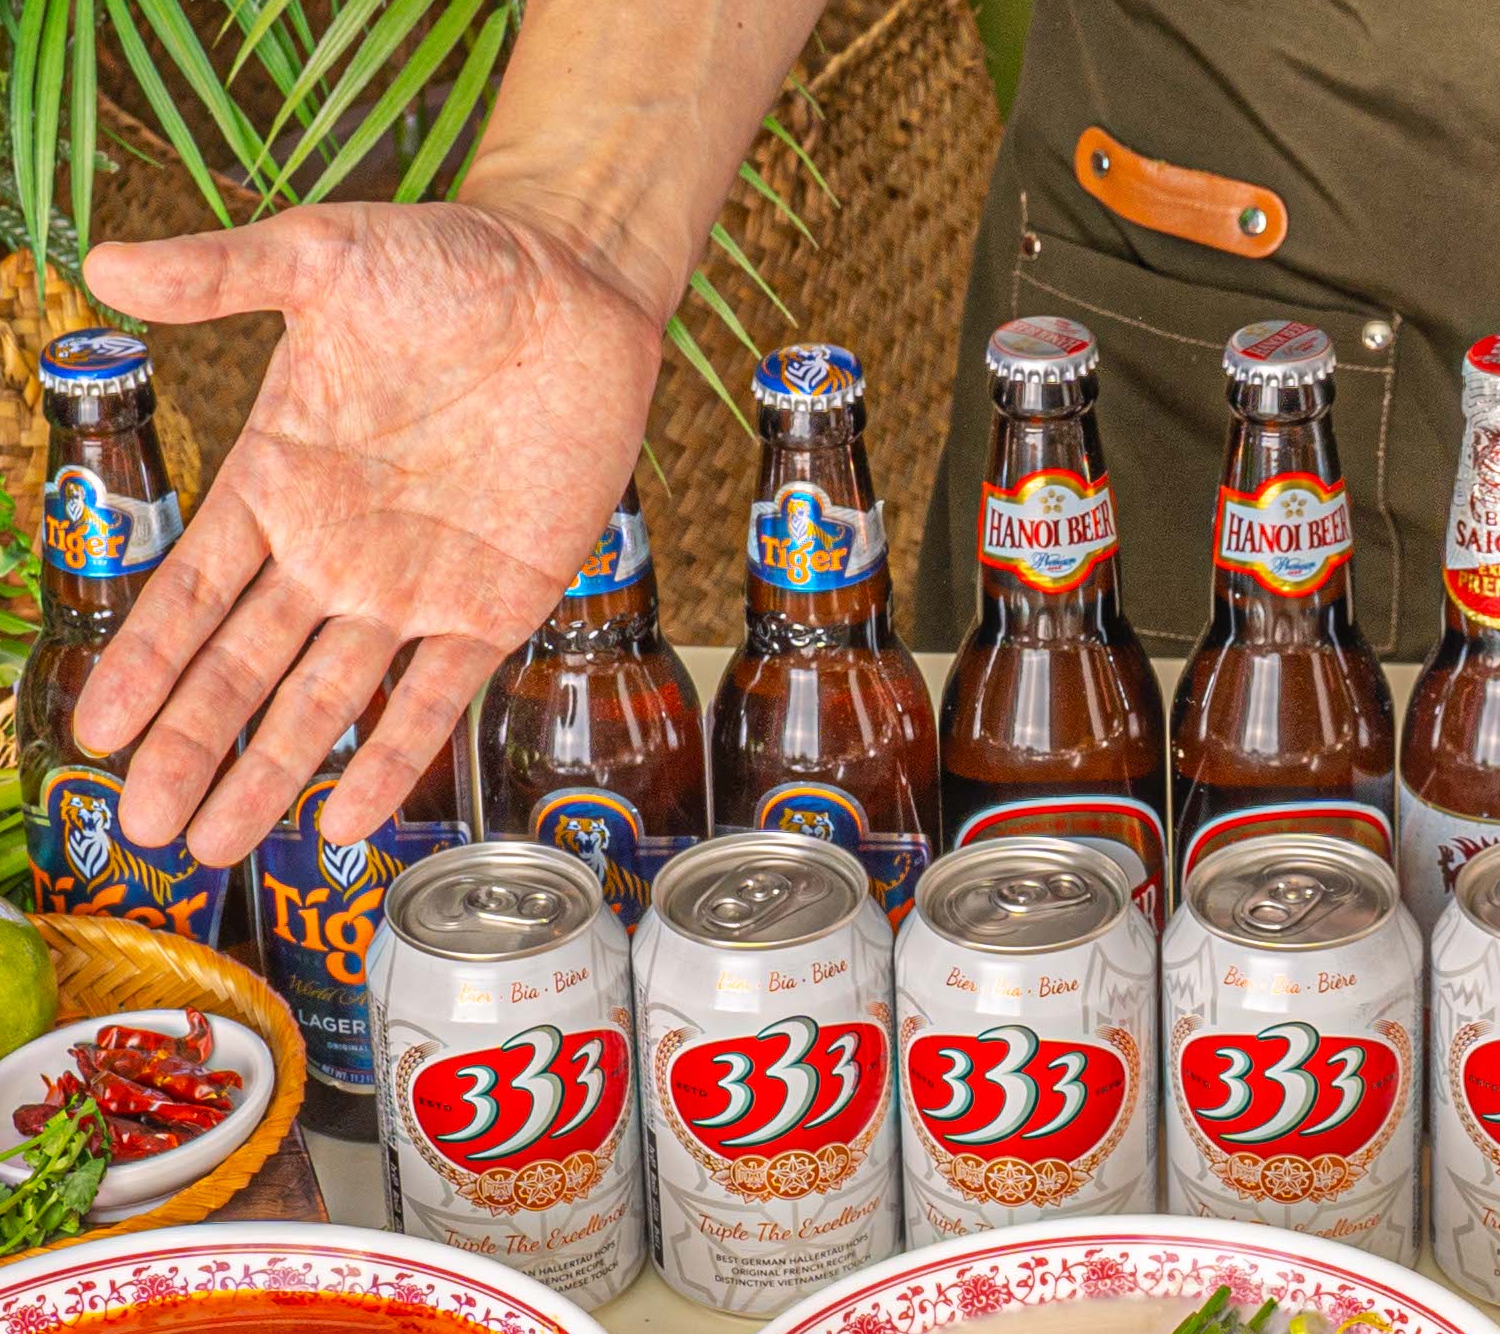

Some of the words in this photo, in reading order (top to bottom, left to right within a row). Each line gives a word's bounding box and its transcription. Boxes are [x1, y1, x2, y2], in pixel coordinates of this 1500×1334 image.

[46, 515, 125, 570] Tiger
[988, 507, 1062, 549] HANOI
[1066, 499, 1114, 546] BEER
[1226, 511, 1302, 553] HANOI
[1307, 503, 1350, 550] BEER
[760, 534, 848, 584] Tiger
[263, 872, 385, 985] Tig
[511, 981, 539, 1004] Bia
[554, 966, 589, 993] Bière
[769, 971, 797, 993] Bia
[812, 958, 848, 985] Bière
[1039, 975, 1080, 999] Bière
[1318, 972, 1357, 995] Bière
[298, 1009, 366, 1035] LAGER
[436, 1024, 604, 1161] 333
[691, 1014, 861, 1147] 333
[922, 1024, 1089, 1145] 333
[1196, 1021, 1365, 1144] 333
[444, 1229, 497, 1254] Triple
[505, 1234, 540, 1255] The
[547, 1203, 627, 1250] Excellence
[699, 1213, 749, 1243] Triple
[757, 1222, 792, 1242] The
[798, 1196, 880, 1239] Excellence
[925, 1202, 967, 1235] Triple
[539, 1252, 593, 1276] HALLERTAU
[594, 1240, 616, 1259] HOPS
[716, 1253, 738, 1264] BEST
[741, 1254, 786, 1266] GERMAN
[789, 1245, 844, 1264] HALLERTAU
[846, 1233, 869, 1250] HOPS
[731, 1267, 780, 1277] ORIGINAL
[783, 1263, 825, 1276] FRENCH
[826, 1251, 857, 1268] RECIPE
[539, 1270, 573, 1284] RENCH
[575, 1259, 606, 1277] RECIPE
[590, 1260, 619, 1281] TOUCH
[715, 1274, 775, 1287] DISTINCTIVE
[778, 1268, 839, 1287] VIETNAMESE
